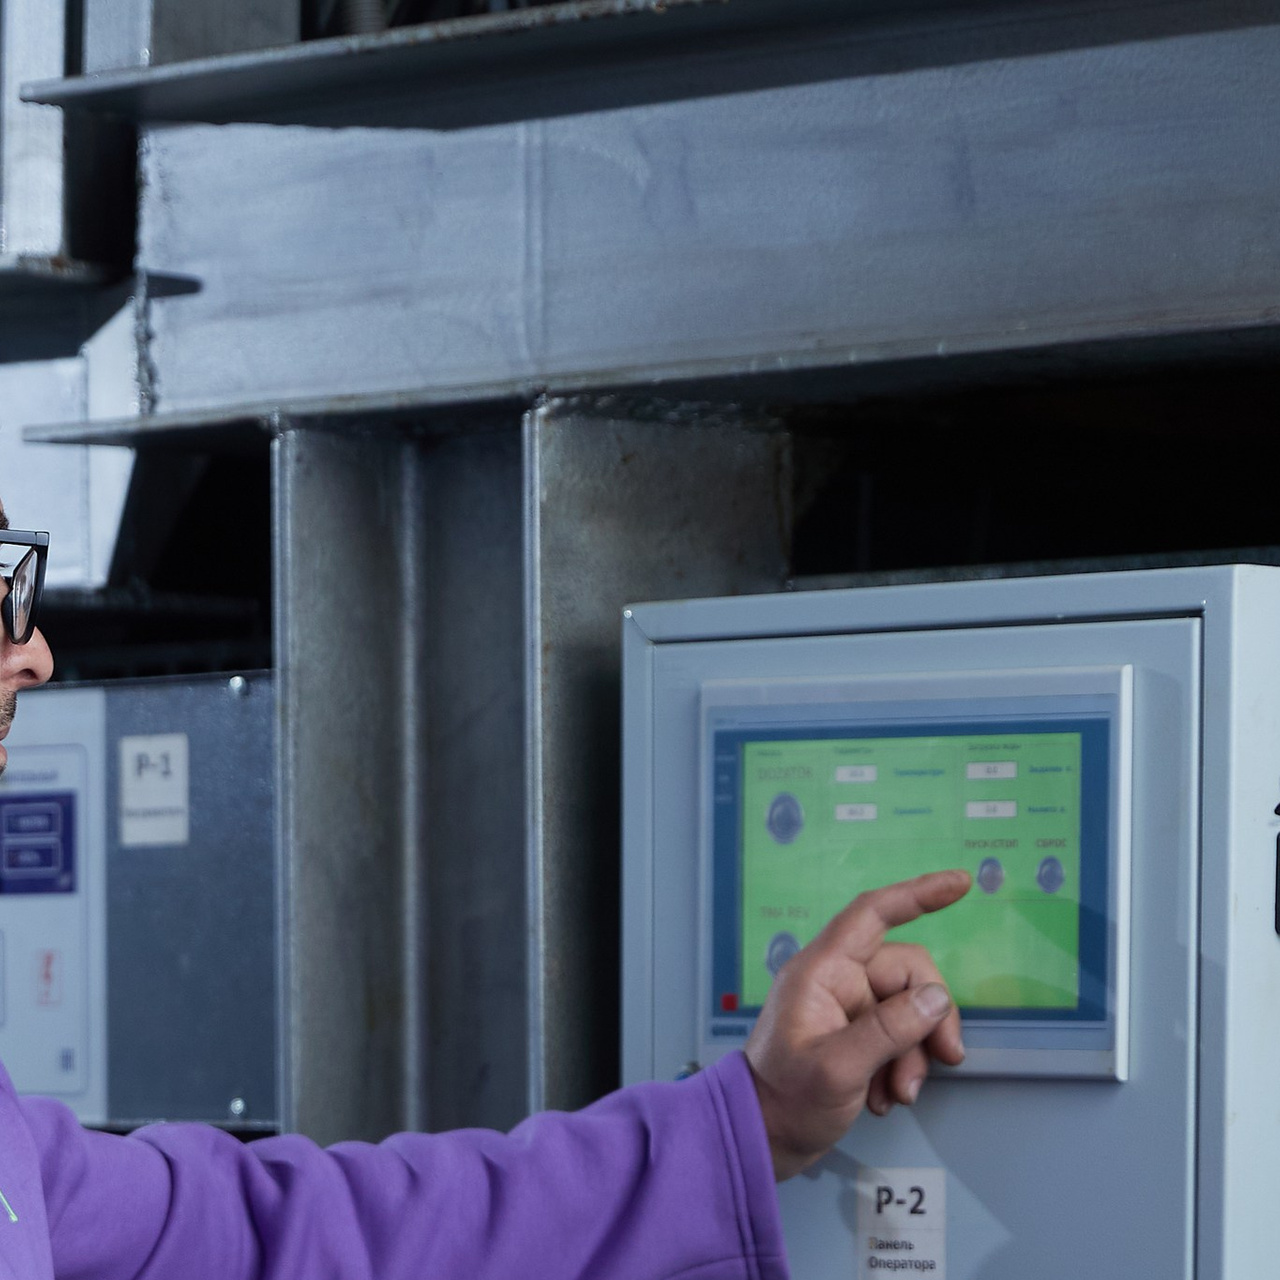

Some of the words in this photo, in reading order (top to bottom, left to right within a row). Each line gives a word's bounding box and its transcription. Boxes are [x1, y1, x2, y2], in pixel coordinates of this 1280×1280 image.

[136, 751, 173, 779] P-1
[876, 1185, 927, 1215] P-2
[868, 1236, 915, 1251] Панель
[867, 1256, 937, 1272] Оператора
